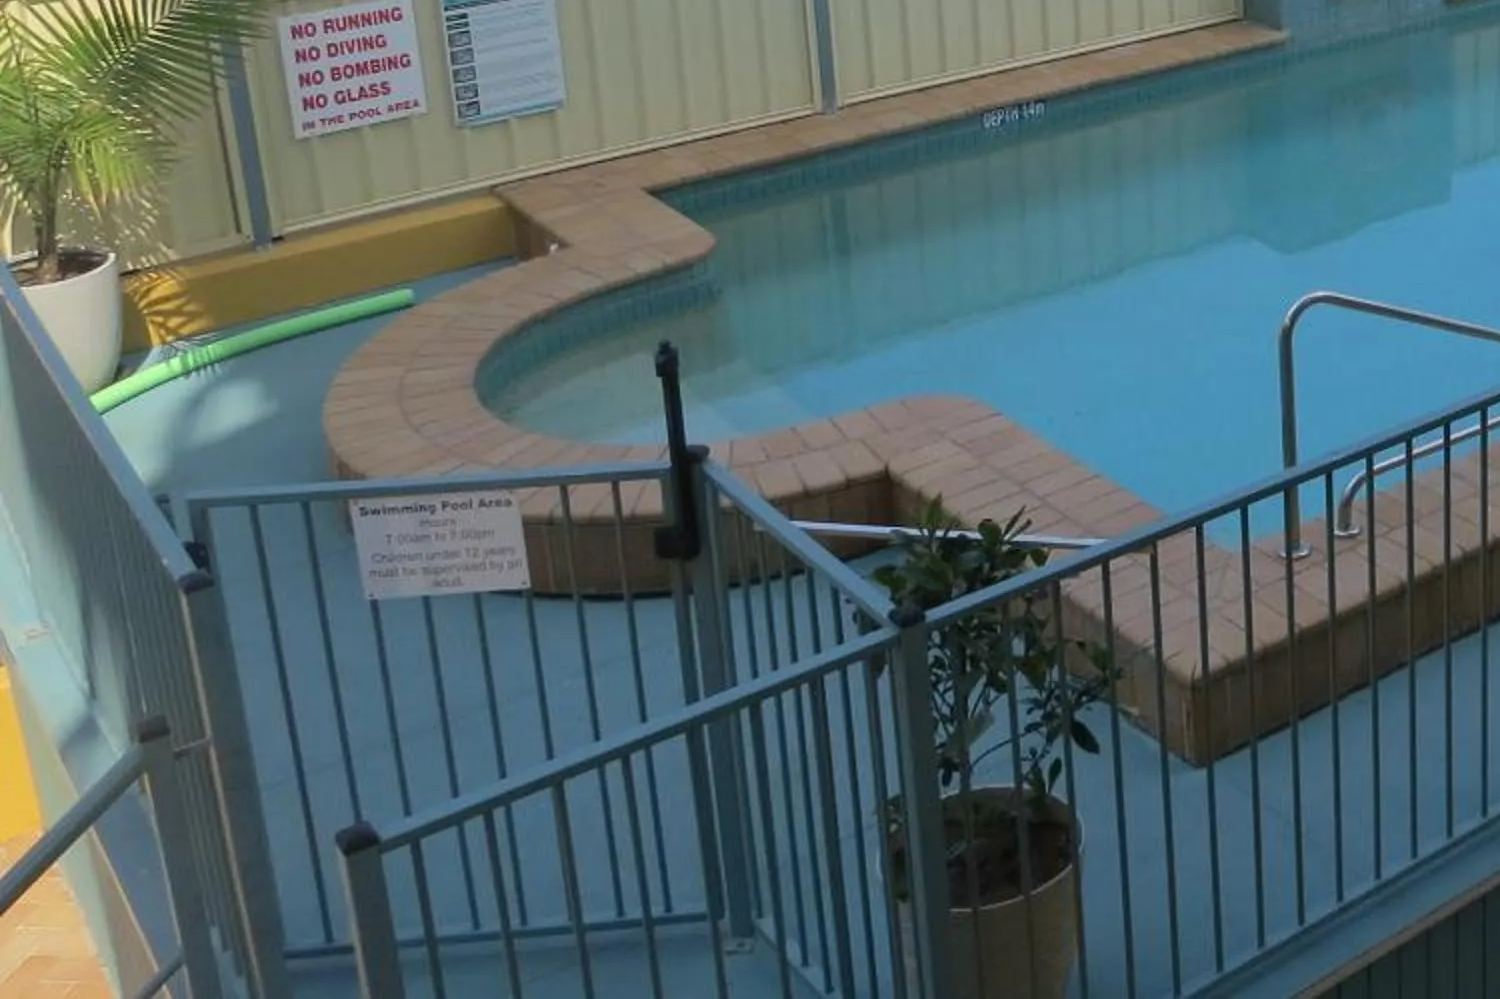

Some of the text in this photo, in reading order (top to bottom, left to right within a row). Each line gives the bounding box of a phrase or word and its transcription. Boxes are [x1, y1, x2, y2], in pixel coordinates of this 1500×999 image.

[290, 6, 403, 40] NO RUNNING
[294, 34, 387, 63] NO DIVING
[298, 53, 412, 88] NO BOMBING
[302, 80, 391, 111] NO GLASS
[302, 99, 421, 132] IN THE POOL AREA
[359, 497, 513, 518] Swimming Pool Area
[465, 547, 480, 559] 12
